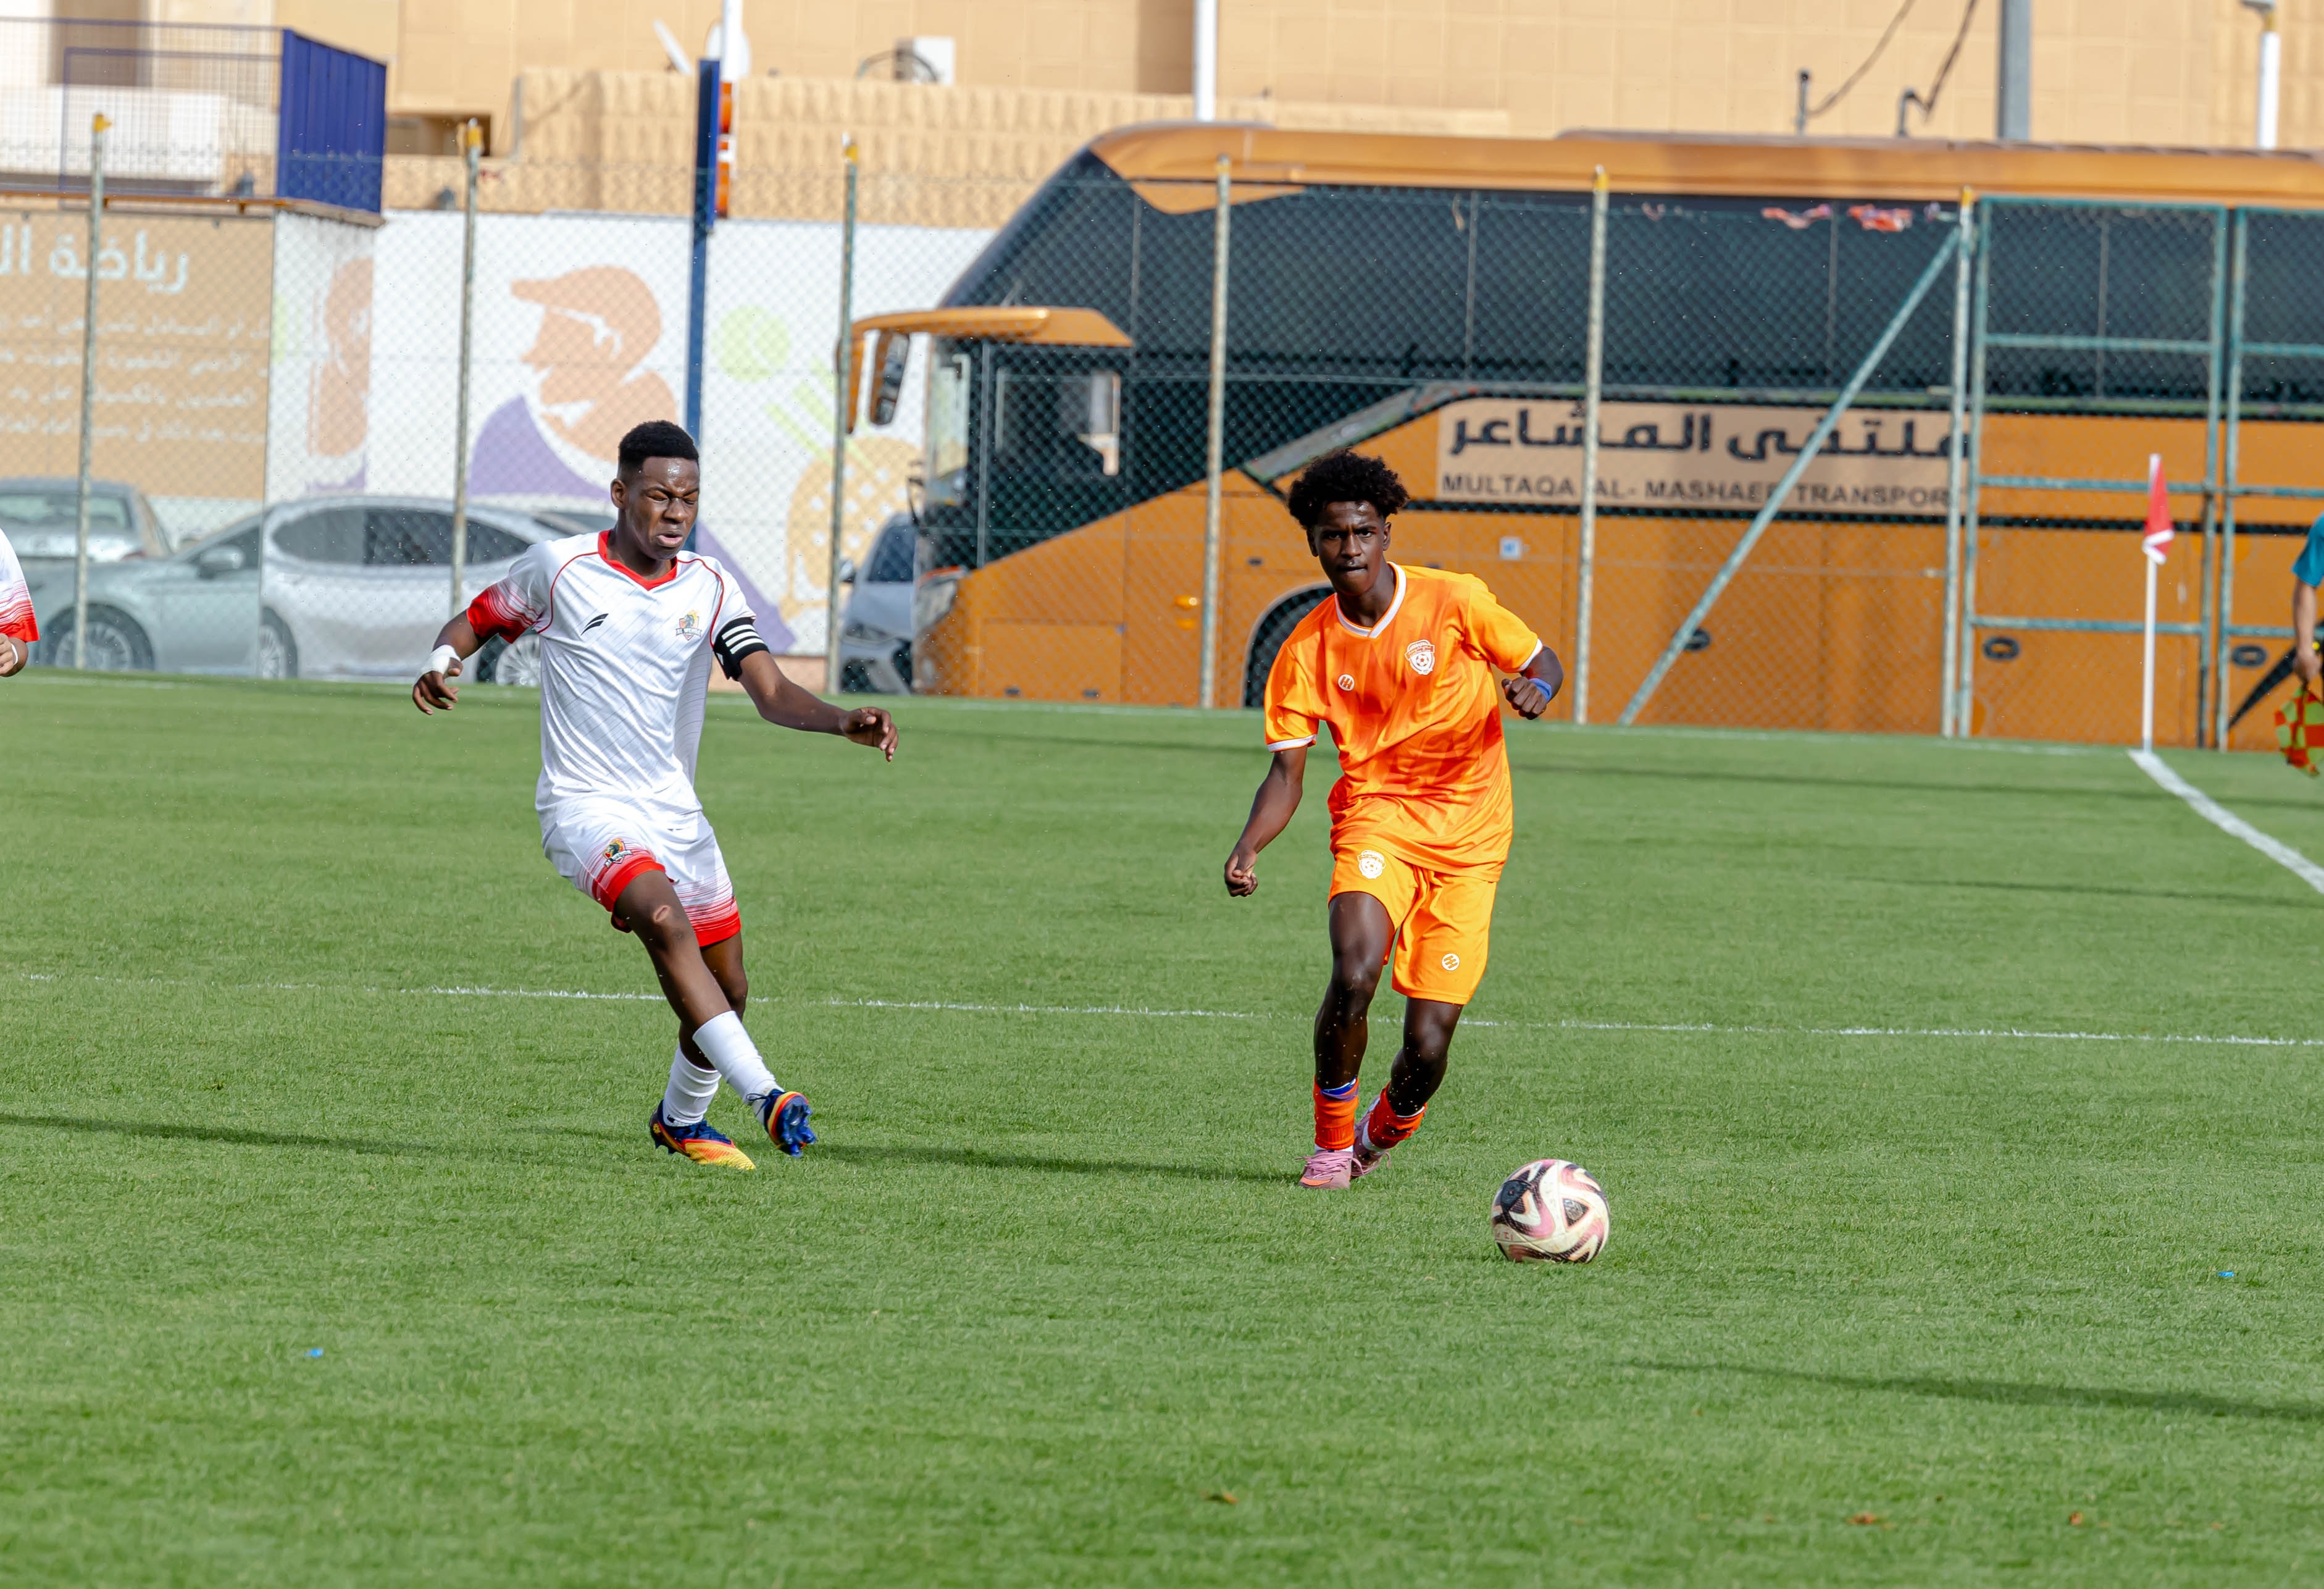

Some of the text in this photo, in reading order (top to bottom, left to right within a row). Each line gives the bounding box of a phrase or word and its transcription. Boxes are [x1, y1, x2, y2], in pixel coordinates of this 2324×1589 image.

[49, 229, 189, 295] رياضة
[1450, 400, 1711, 455] المشاعر
[1442, 475, 1574, 496] MULTAQA
[1797, 484, 1951, 508] TRANSPOR
